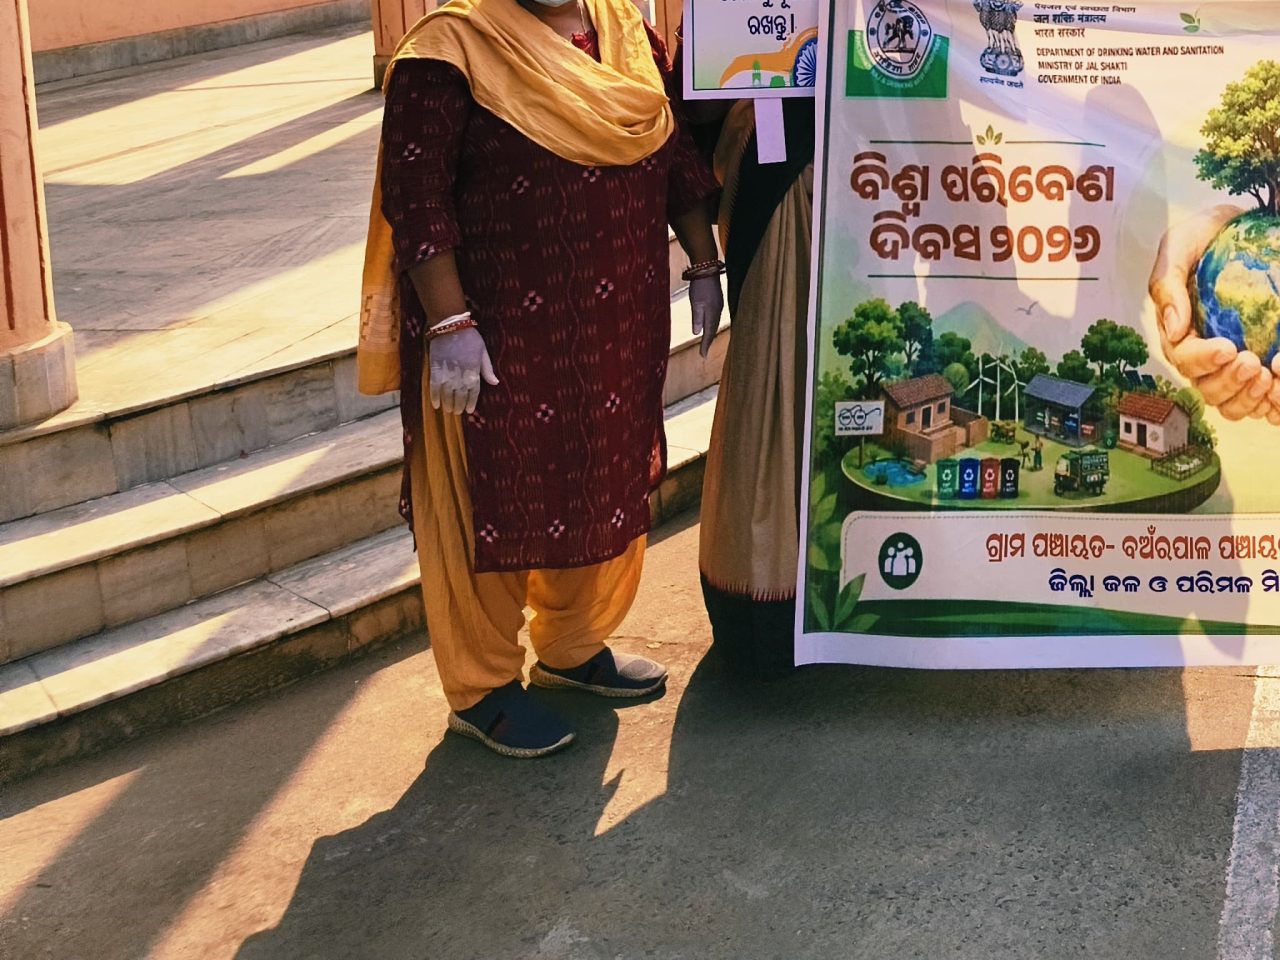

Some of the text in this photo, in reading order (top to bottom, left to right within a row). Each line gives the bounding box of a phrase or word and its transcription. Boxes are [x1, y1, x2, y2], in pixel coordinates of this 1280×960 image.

[1033, 12, 1107, 24] जल शक्ति मंत्रालय
[1034, 28, 1085, 38] भारत सरकार
[1036, 45, 1224, 57] DEPARTMENT OF DRINKING WATER AND SANITATION
[1038, 61, 1127, 71] MINISTRY OF JAL SHAKTI
[1038, 74, 1121, 85] GOVERNMENT OF INDIA
[849, 150, 1115, 217] ବିଶ୍ୱ ପରିବେଶ
[869, 210, 1102, 263] ଦିବସ ୨୦୨୬
[986, 532, 1025, 562] ଗ୍ରାମ
[1048, 568, 1095, 598] ଜିଲ୍ଲା
[1102, 575, 1140, 593] ଜଳ
[1148, 575, 1168, 593] ଓ
[1177, 570, 1253, 593] ପରିମଳ
